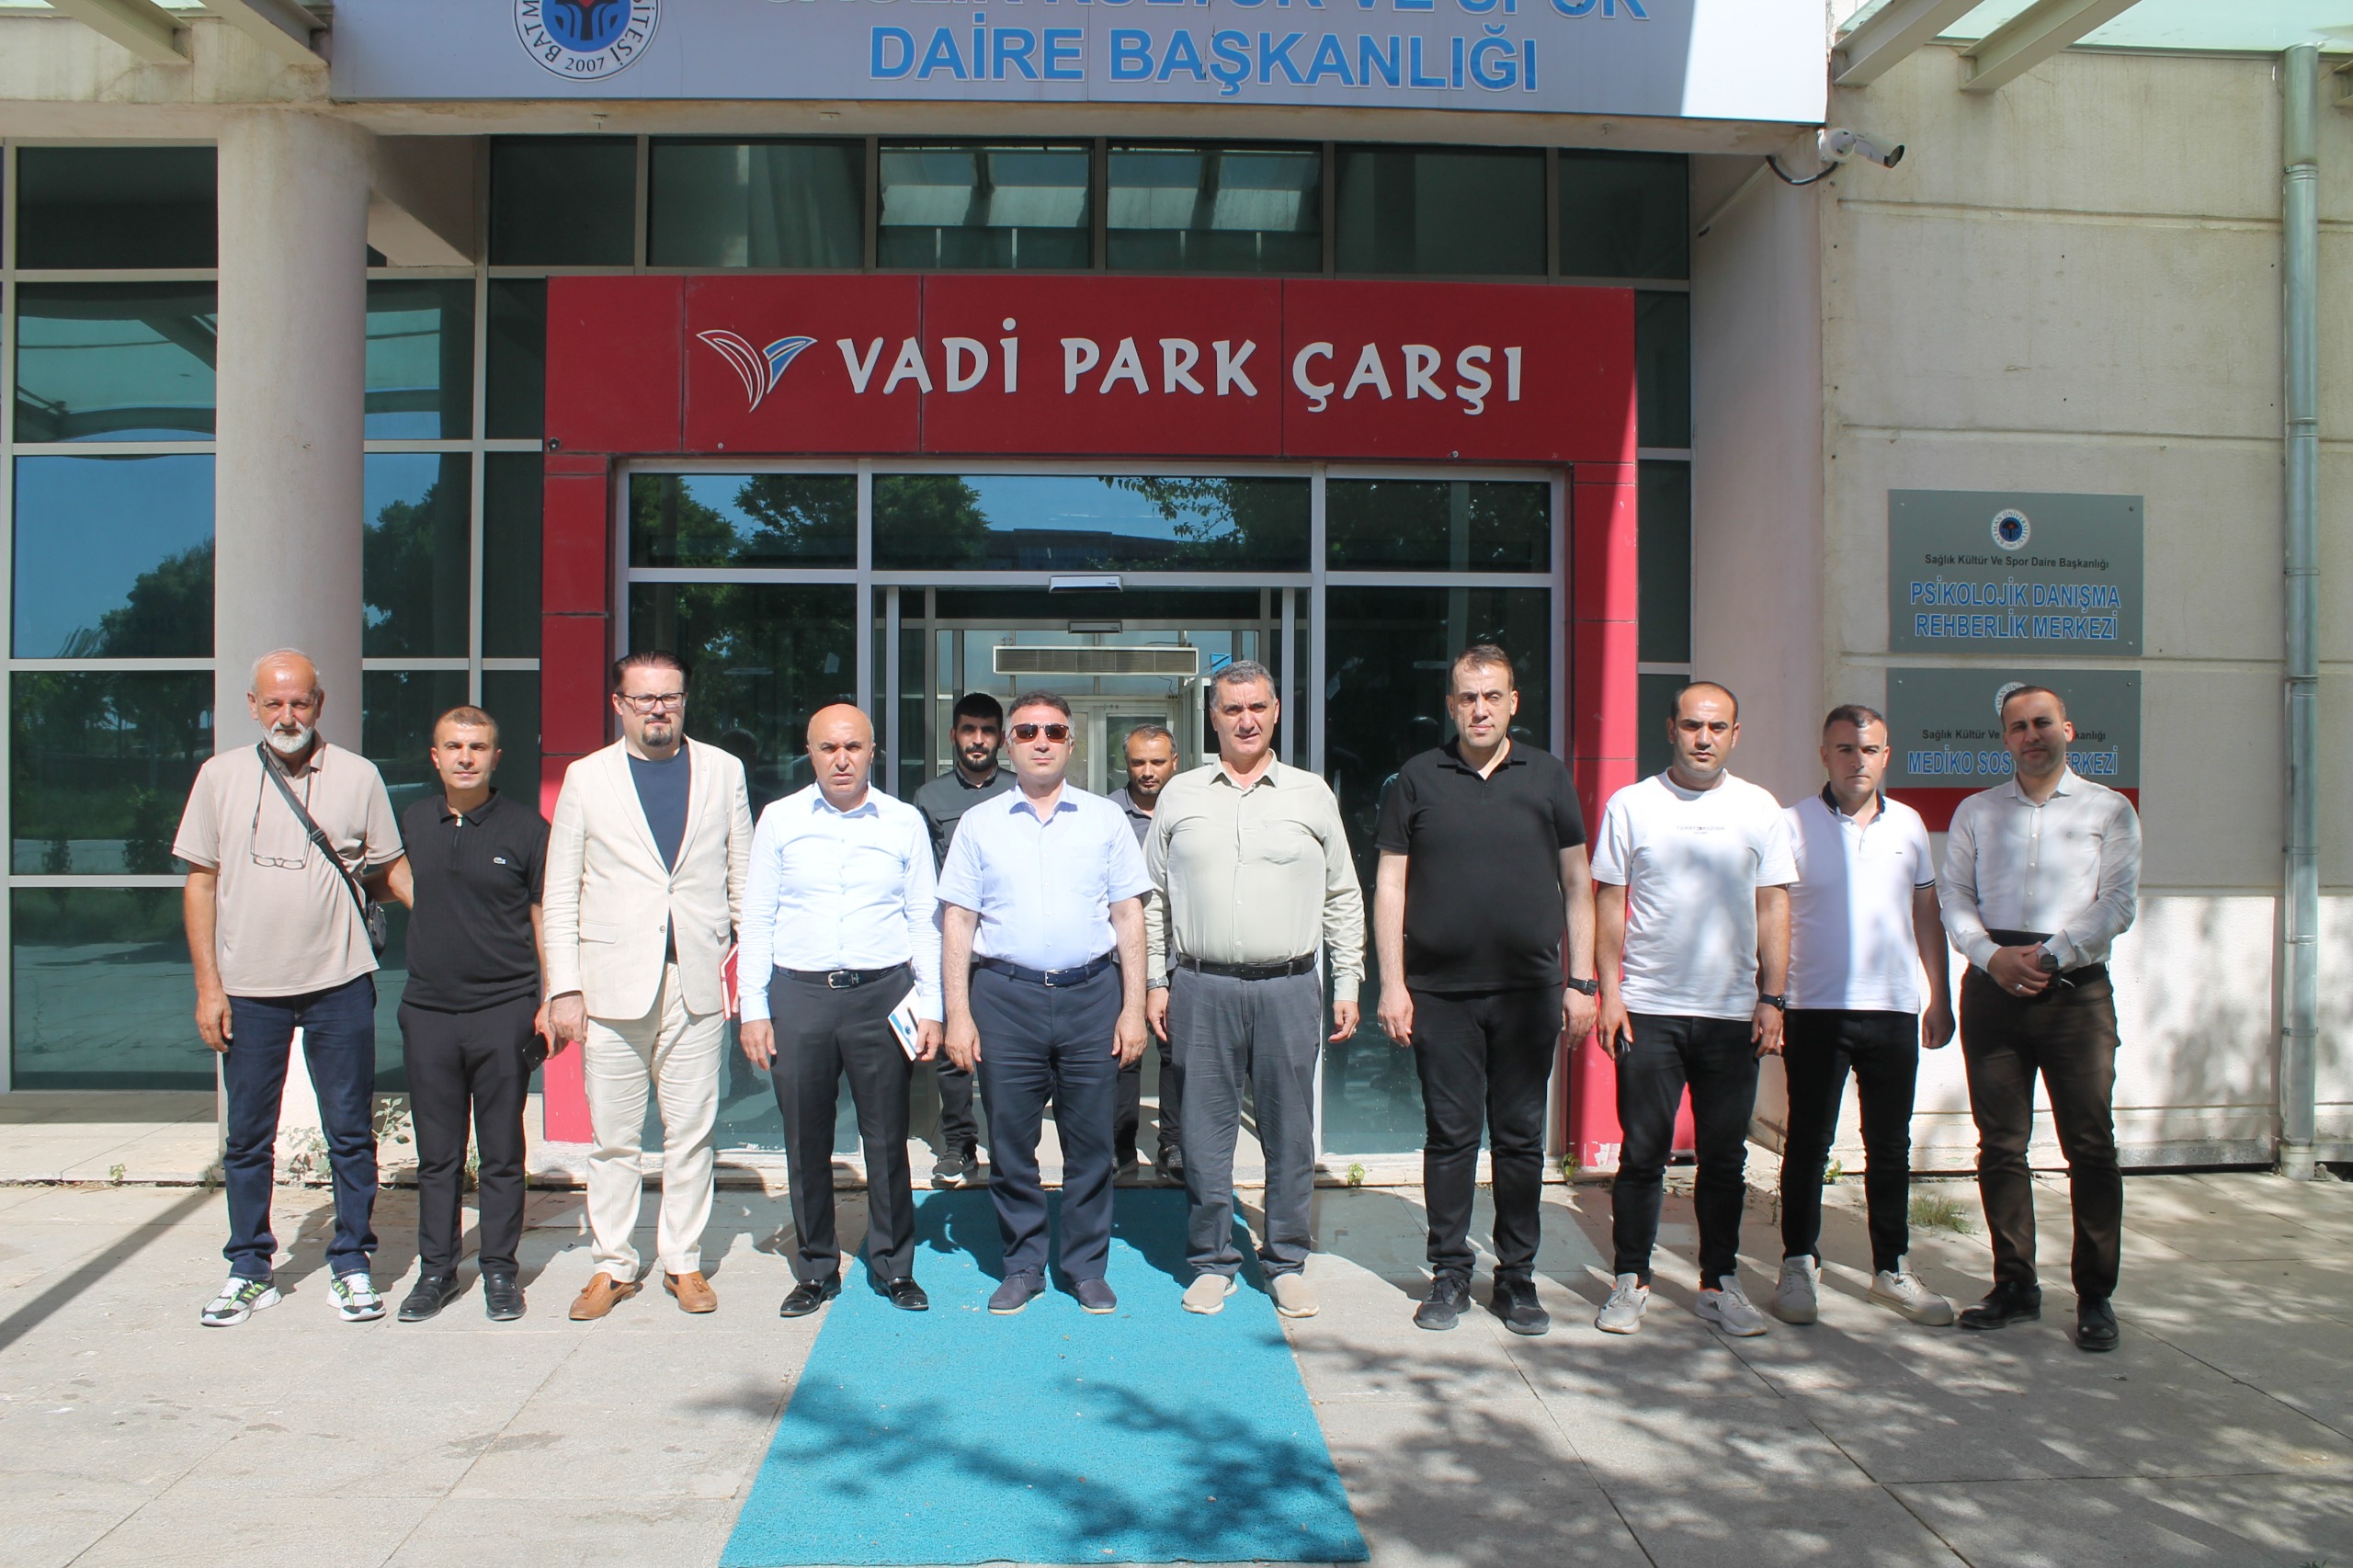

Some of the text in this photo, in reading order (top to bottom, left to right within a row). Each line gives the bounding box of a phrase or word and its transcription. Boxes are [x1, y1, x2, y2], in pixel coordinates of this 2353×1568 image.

[521, 0, 563, 62] BATM
[564, 57, 605, 73] 2007
[870, 12, 1538, 96] DAİRE BAŞKANLIĞI
[836, 317, 1522, 415] VADİ PARK ÇARŞI
[1925, 553, 2109, 571] Sağlık Kültür Ve Spor Daire Başkanlığı
[1911, 575, 2121, 613] PSİKOLOJİK DANIŞMA
[1915, 608, 2118, 640] REHBERLİK MERKEZİ
[1922, 729, 2106, 743] Sağlık Kültür Ve kanlığı
[1908, 744, 1974, 775] MEDİKO
[1977, 750, 2013, 775] SOS
